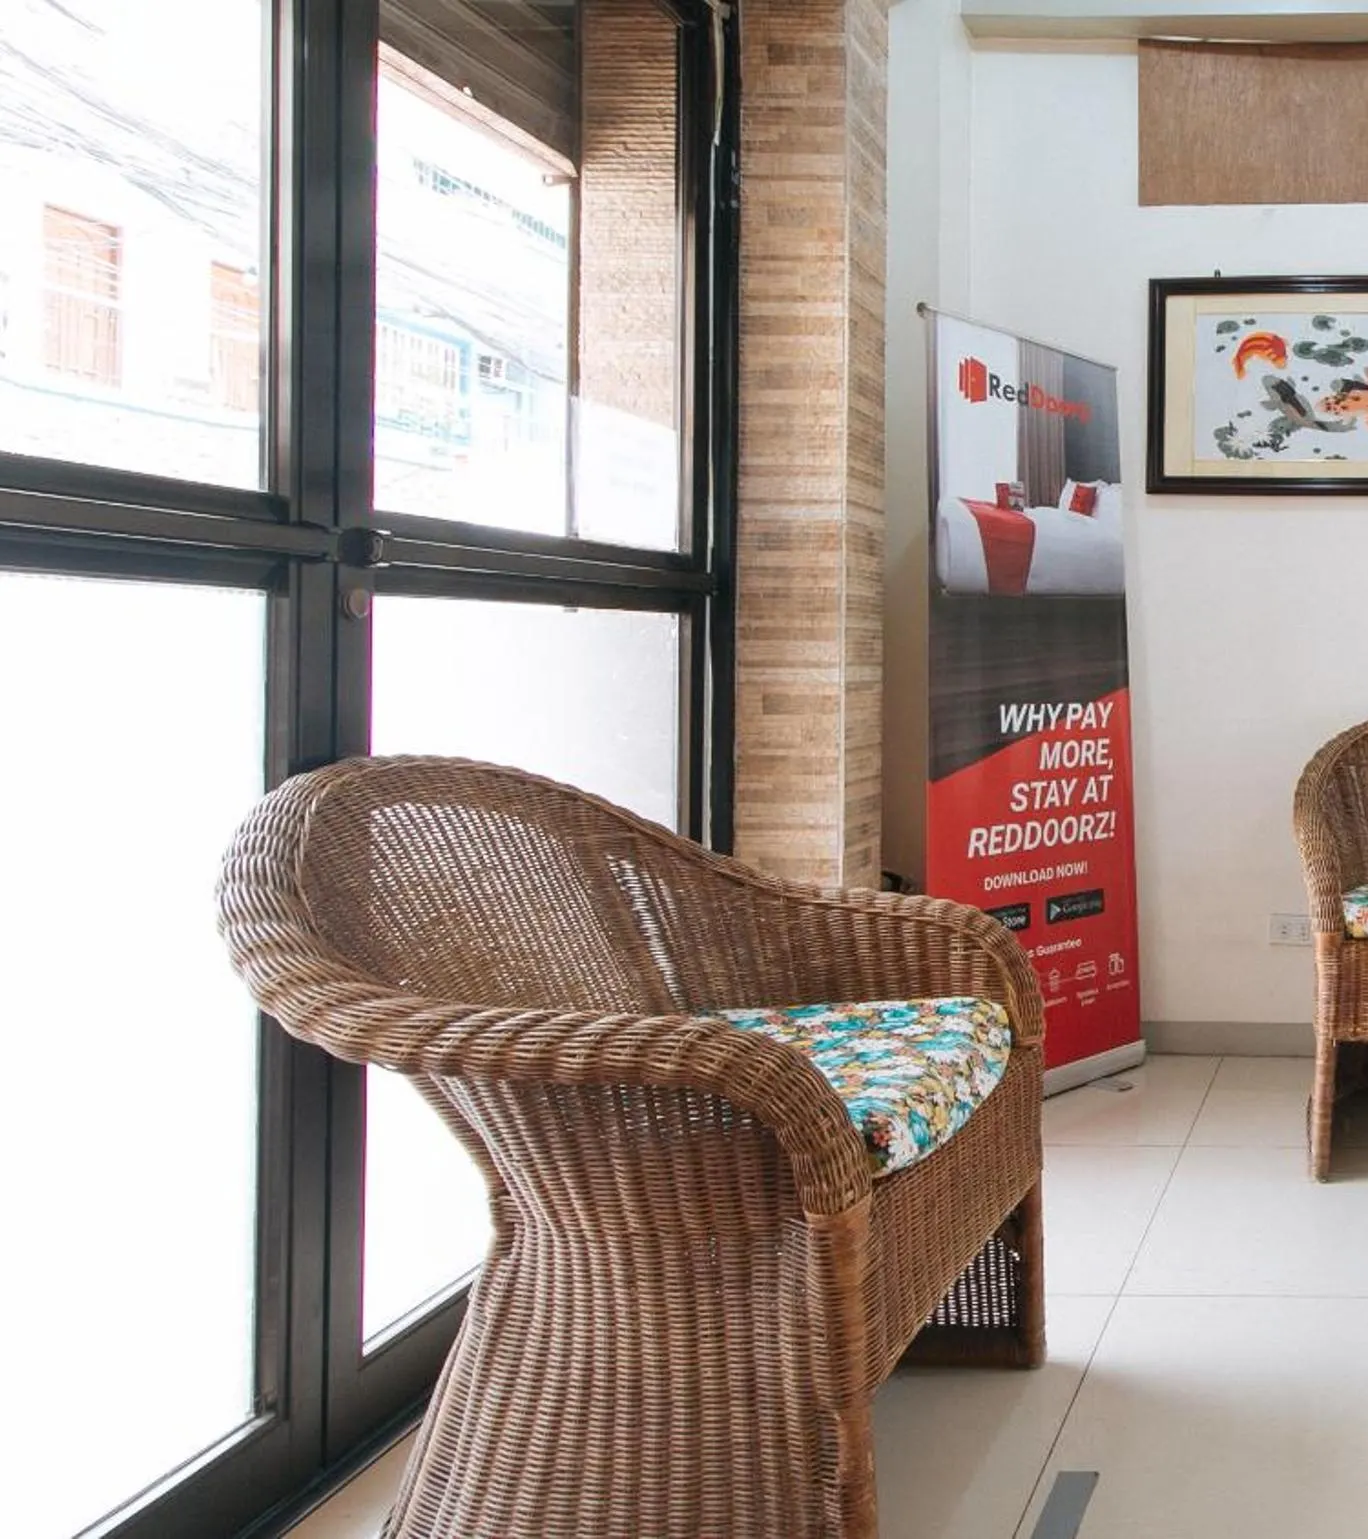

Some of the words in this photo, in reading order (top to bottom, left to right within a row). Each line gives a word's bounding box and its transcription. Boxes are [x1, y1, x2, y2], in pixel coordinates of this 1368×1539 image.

[1000, 703, 1063, 734] WHY
[1065, 702, 1113, 731] PAY
[1039, 738, 1114, 771] MORE,
[1010, 778, 1078, 812] STAY
[1081, 774, 1113, 805] AT
[967, 811, 1116, 859] REDDOORZ!
[984, 867, 1055, 891] DOWNLOAD
[1056, 860, 1088, 879] NOW!
[1035, 938, 1082, 957] Guarantee
